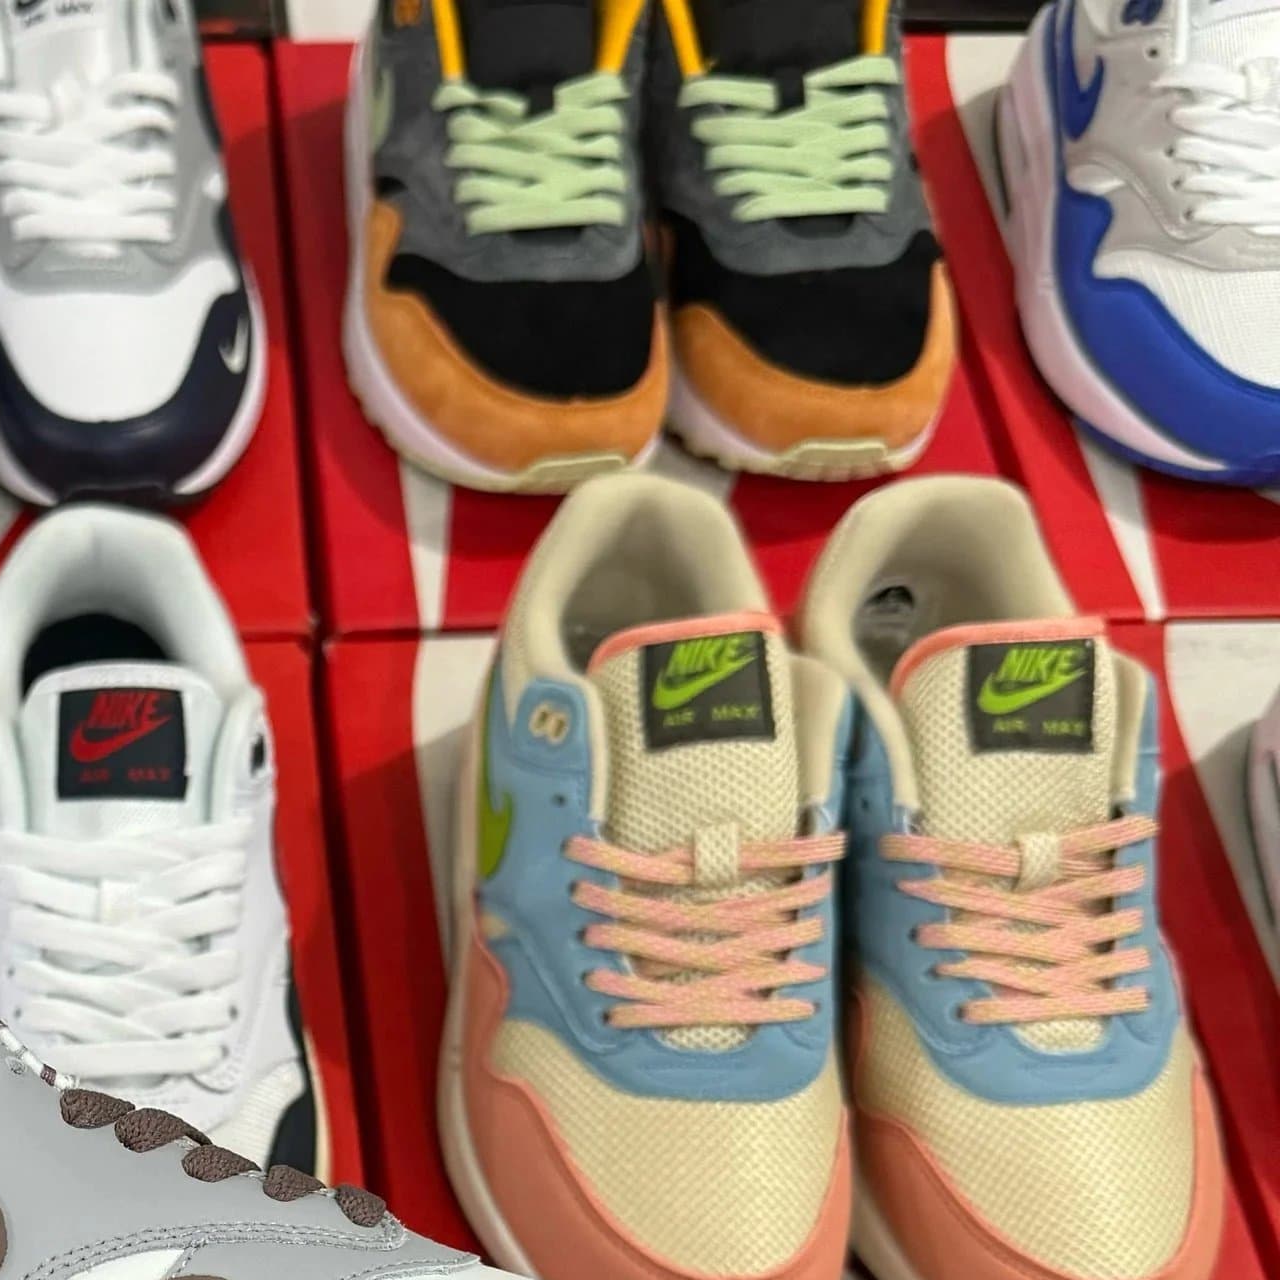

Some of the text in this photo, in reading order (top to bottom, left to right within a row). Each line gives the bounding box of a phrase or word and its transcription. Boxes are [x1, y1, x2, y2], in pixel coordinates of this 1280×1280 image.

[666, 634, 746, 675] NIKE
[996, 648, 1077, 682] NIKE
[86, 690, 160, 728] NIKE
[663, 703, 759, 728] AIR MAX
